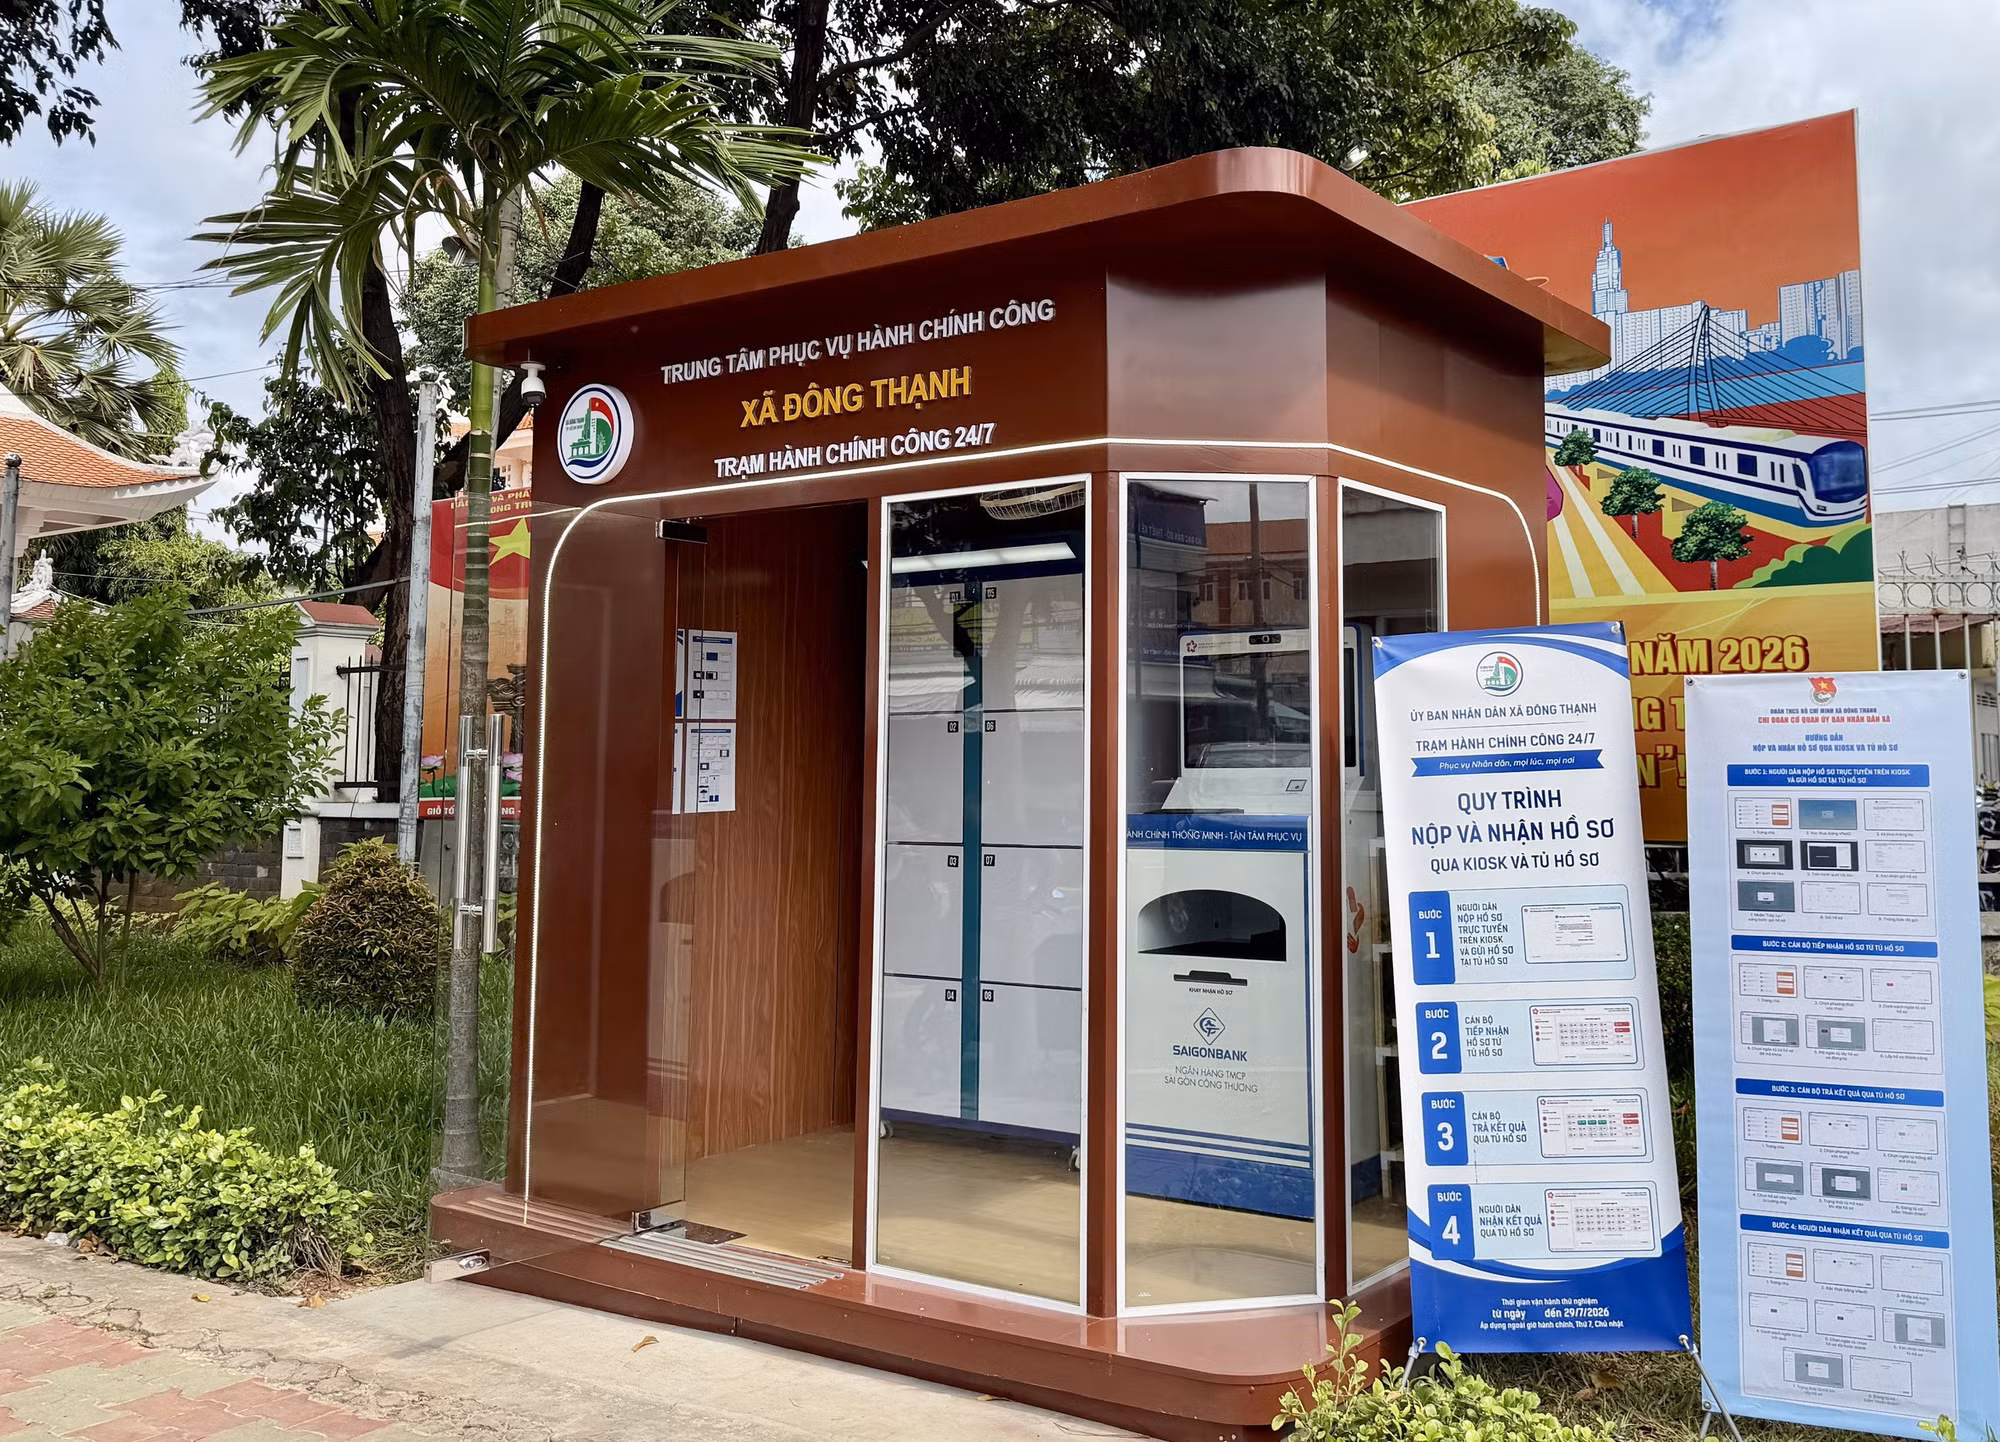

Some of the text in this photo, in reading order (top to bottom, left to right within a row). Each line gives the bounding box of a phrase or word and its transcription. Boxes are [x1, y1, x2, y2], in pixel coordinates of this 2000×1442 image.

[661, 299, 1055, 384] TRUNG TÂM PHỤC VỤ HÀNH CHÍNH CÔNG
[741, 366, 972, 428] XÃ ĐÔNG THẠNH
[715, 423, 996, 479] TRẠM HÀNH CHÍNH CÔNG 24/7
[508, 489, 531, 499] PHÁ
[1630, 633, 1809, 675] NĂM 2026
[1411, 703, 1596, 721] ỦY BAN NHÂN DÂN XÃ ĐÔNG THẠNH
[1416, 733, 1595, 753] TRẠM HÀNH CHÍNH CÔNG 24/7
[1440, 762, 1458, 770] Phục
[1472, 760, 1493, 768] Nhân
[1495, 759, 1512, 767] dân,
[1514, 759, 1528, 767] mọi
[1530, 758, 1544, 766] lúc,
[1546, 757, 1560, 766] mọi
[1562, 756, 1575, 764] nơi
[1458, 787, 1561, 815] QUY TRÌNH
[1127, 828, 1143, 838] ÀNH
[1145, 829, 1169, 839] CHÍNH
[1172, 829, 1200, 839] THÔNG
[1202, 831, 1223, 839] MINH
[1230, 831, 1245, 841] TẬN
[1248, 831, 1265, 840] TÂM
[1267, 832, 1288, 842] PHỤC
[1291, 833, 1302, 842] VỤ
[1412, 815, 1614, 849] NỘP VÀ NHẬN HỒ SƠ
[950, 857, 957, 866] 03
[986, 856, 993, 864] 07
[1431, 850, 1599, 874] QUA KIOSK VÀ TỦ HỒ SƠ
[1457, 902, 1497, 911] NGƯỜI DÂN
[1418, 909, 1442, 919] BƯỚC
[1458, 912, 1503, 925] NỘP HỒ SƠ
[1458, 923, 1508, 936] TRỰC TUYẾN
[1426, 932, 1440, 958] 1
[1459, 936, 1478, 944] TRÊN
[1460, 944, 1514, 955] VÀ GỬI HỒ SƠ
[1461, 958, 1471, 967] TẠI
[1473, 957, 1482, 965] TỦ
[1485, 956, 1495, 965] HỒ
[1425, 1008, 1449, 1018] BƯỚC
[1465, 1015, 1493, 1025] CÁN BỘ
[1465, 1025, 1509, 1037] TIẾP NHẬN
[1431, 1032, 1448, 1059] 2
[1467, 1037, 1477, 1046] HỒ
[1480, 1038, 1490, 1046] SƠ
[1173, 1045, 1248, 1061] SAIGONBANK
[1467, 1048, 1502, 1057] TỦ HỒ SƠ
[1175, 1065, 1246, 1080] NGÂN HÀNG TMCP
[1165, 1074, 1258, 1093] SÀI GÒN CÔNG THƯƠNG
[1431, 1098, 1455, 1109] BƯỚC
[1472, 1111, 1500, 1121] CÁN BỘ
[1472, 1121, 1526, 1133] TRẢ KẾT QUẢ
[1437, 1122, 1454, 1151] 3
[1474, 1134, 1527, 1144] QUA TỦ HỒ SƠ
[1437, 1191, 1462, 1202] BƯỚC
[1479, 1204, 1520, 1213] NGƯỜI DÂN
[1480, 1214, 1542, 1227] NHẬN KẾT QUẢ
[1442, 1216, 1460, 1244] 4
[1480, 1227, 1534, 1238] QUA TỦ HỒ SƠ
[1492, 1307, 1609, 1319] từ ngày đến 29/7/2026
